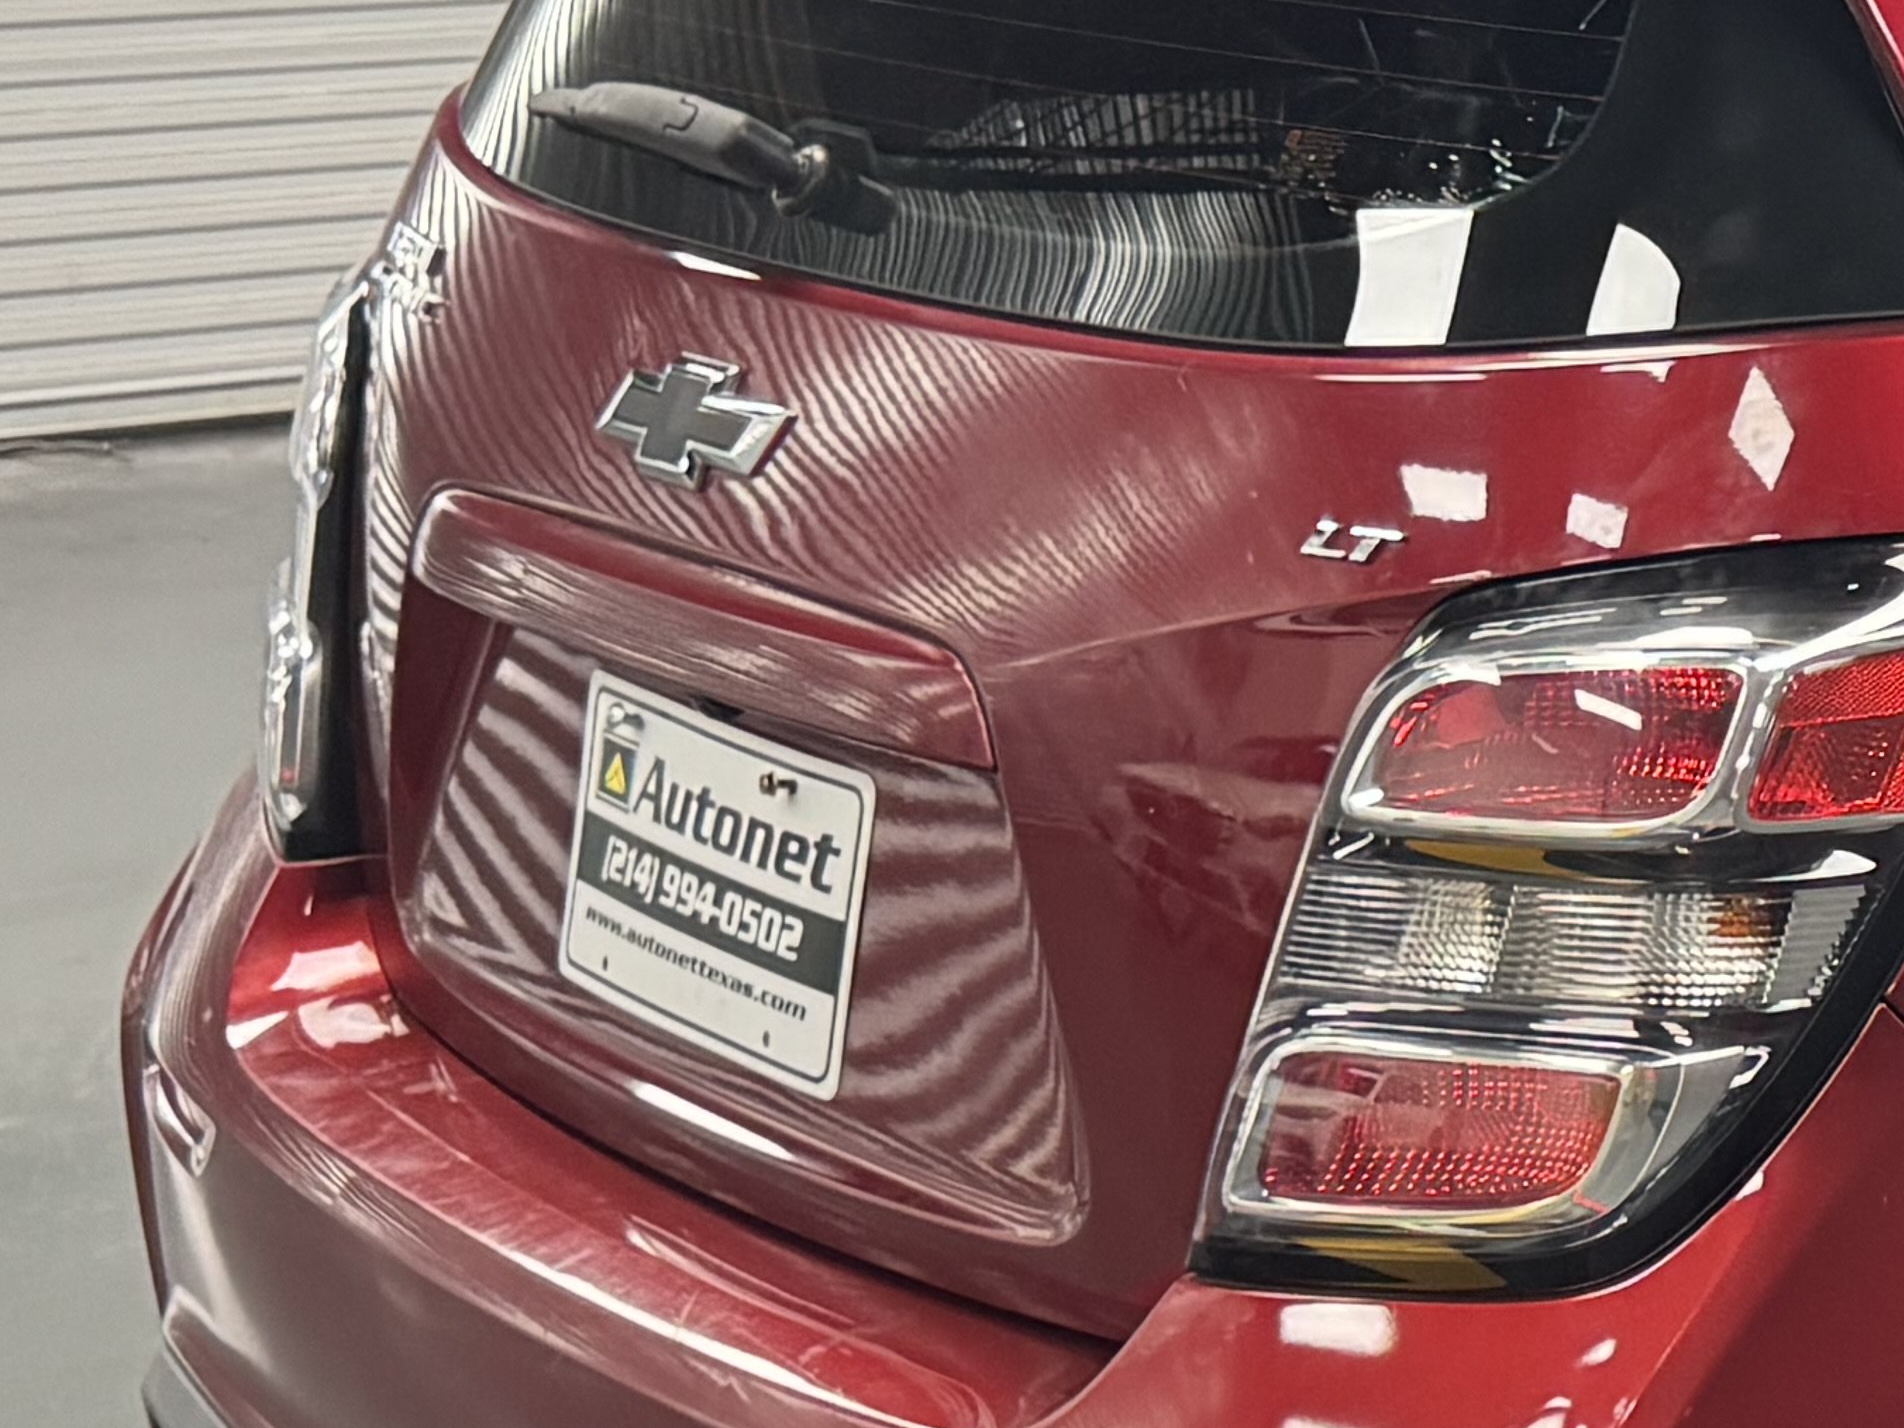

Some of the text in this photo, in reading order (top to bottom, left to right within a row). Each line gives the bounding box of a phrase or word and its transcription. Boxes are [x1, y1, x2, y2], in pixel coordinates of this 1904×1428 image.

[1300, 519, 1405, 563] LT
[633, 755, 841, 895] Autonet
[600, 835, 804, 962] (214) 994-0502
